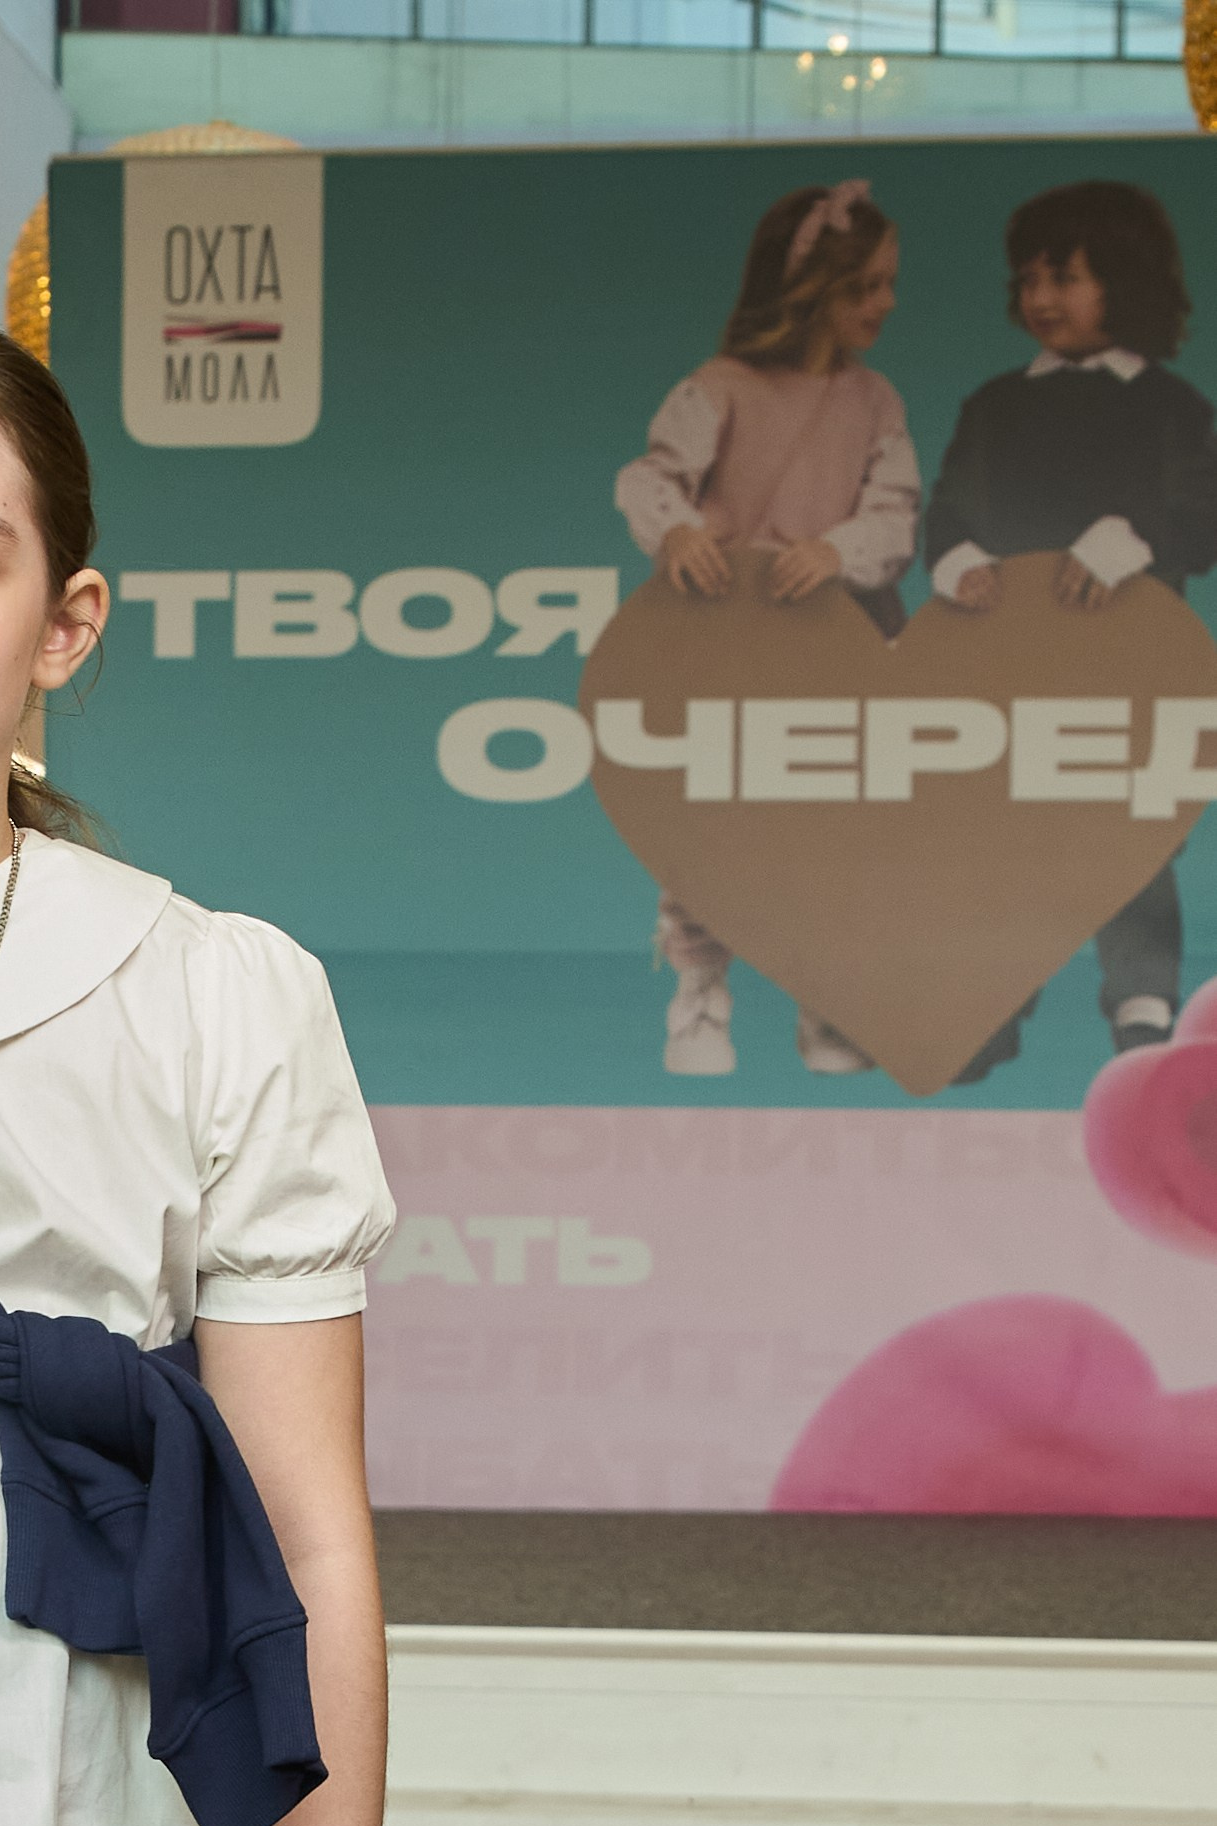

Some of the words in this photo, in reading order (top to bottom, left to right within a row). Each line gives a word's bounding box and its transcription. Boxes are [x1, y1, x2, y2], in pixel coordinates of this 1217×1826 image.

[164, 223, 282, 304] ОХТА
[164, 351, 281, 403] МОЛЛ
[119, 566, 619, 658] ТВОЯ
